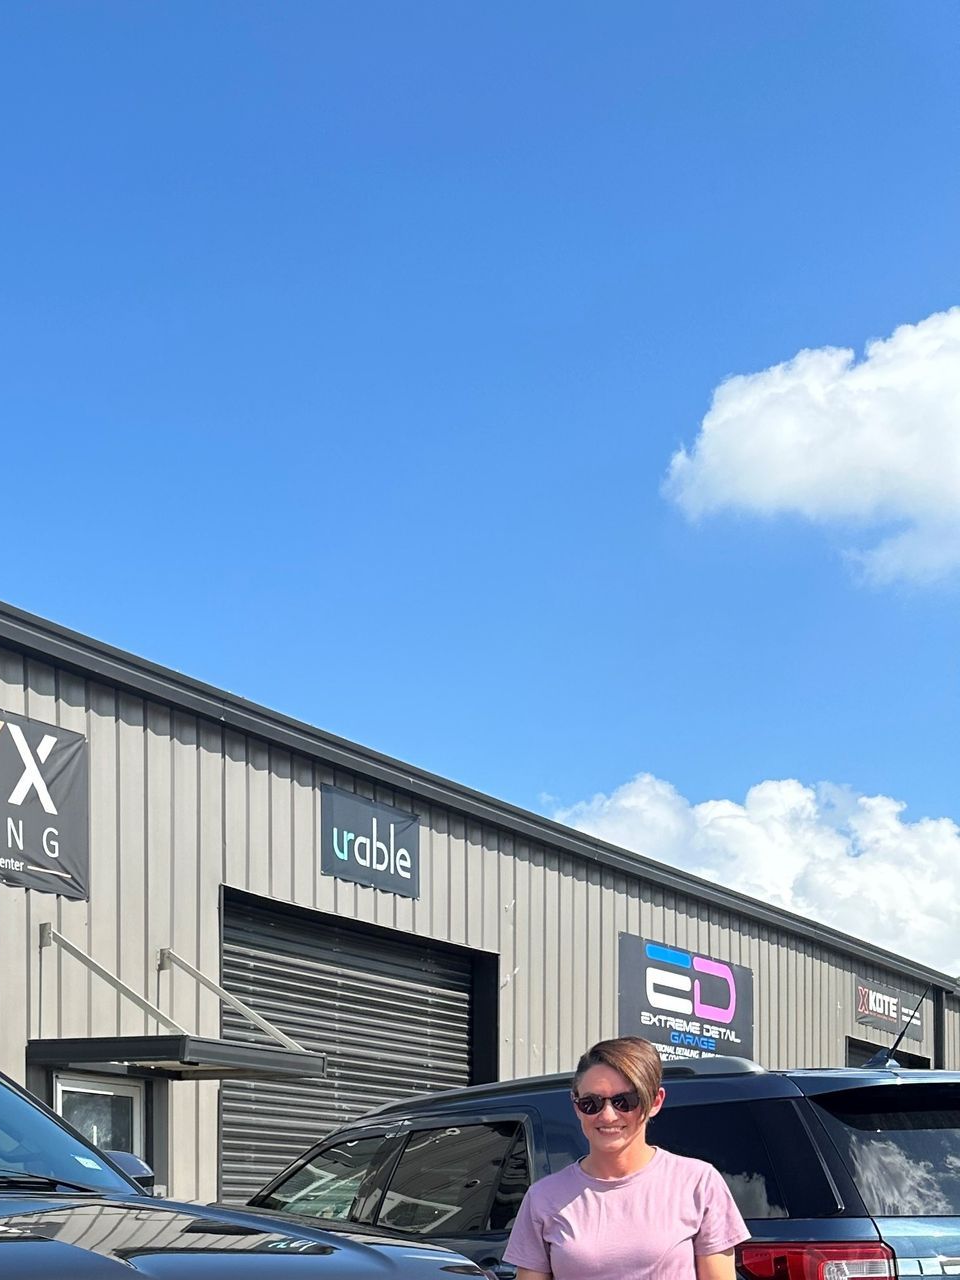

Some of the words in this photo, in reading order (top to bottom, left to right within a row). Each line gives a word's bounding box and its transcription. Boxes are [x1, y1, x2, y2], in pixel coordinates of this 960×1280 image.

[332, 817, 411, 879] urable
[645, 943, 737, 1024] ED
[640, 1011, 700, 1035] EXTREME
[703, 1024, 741, 1043] DETAIL
[670, 1031, 716, 1051] GARAGE
